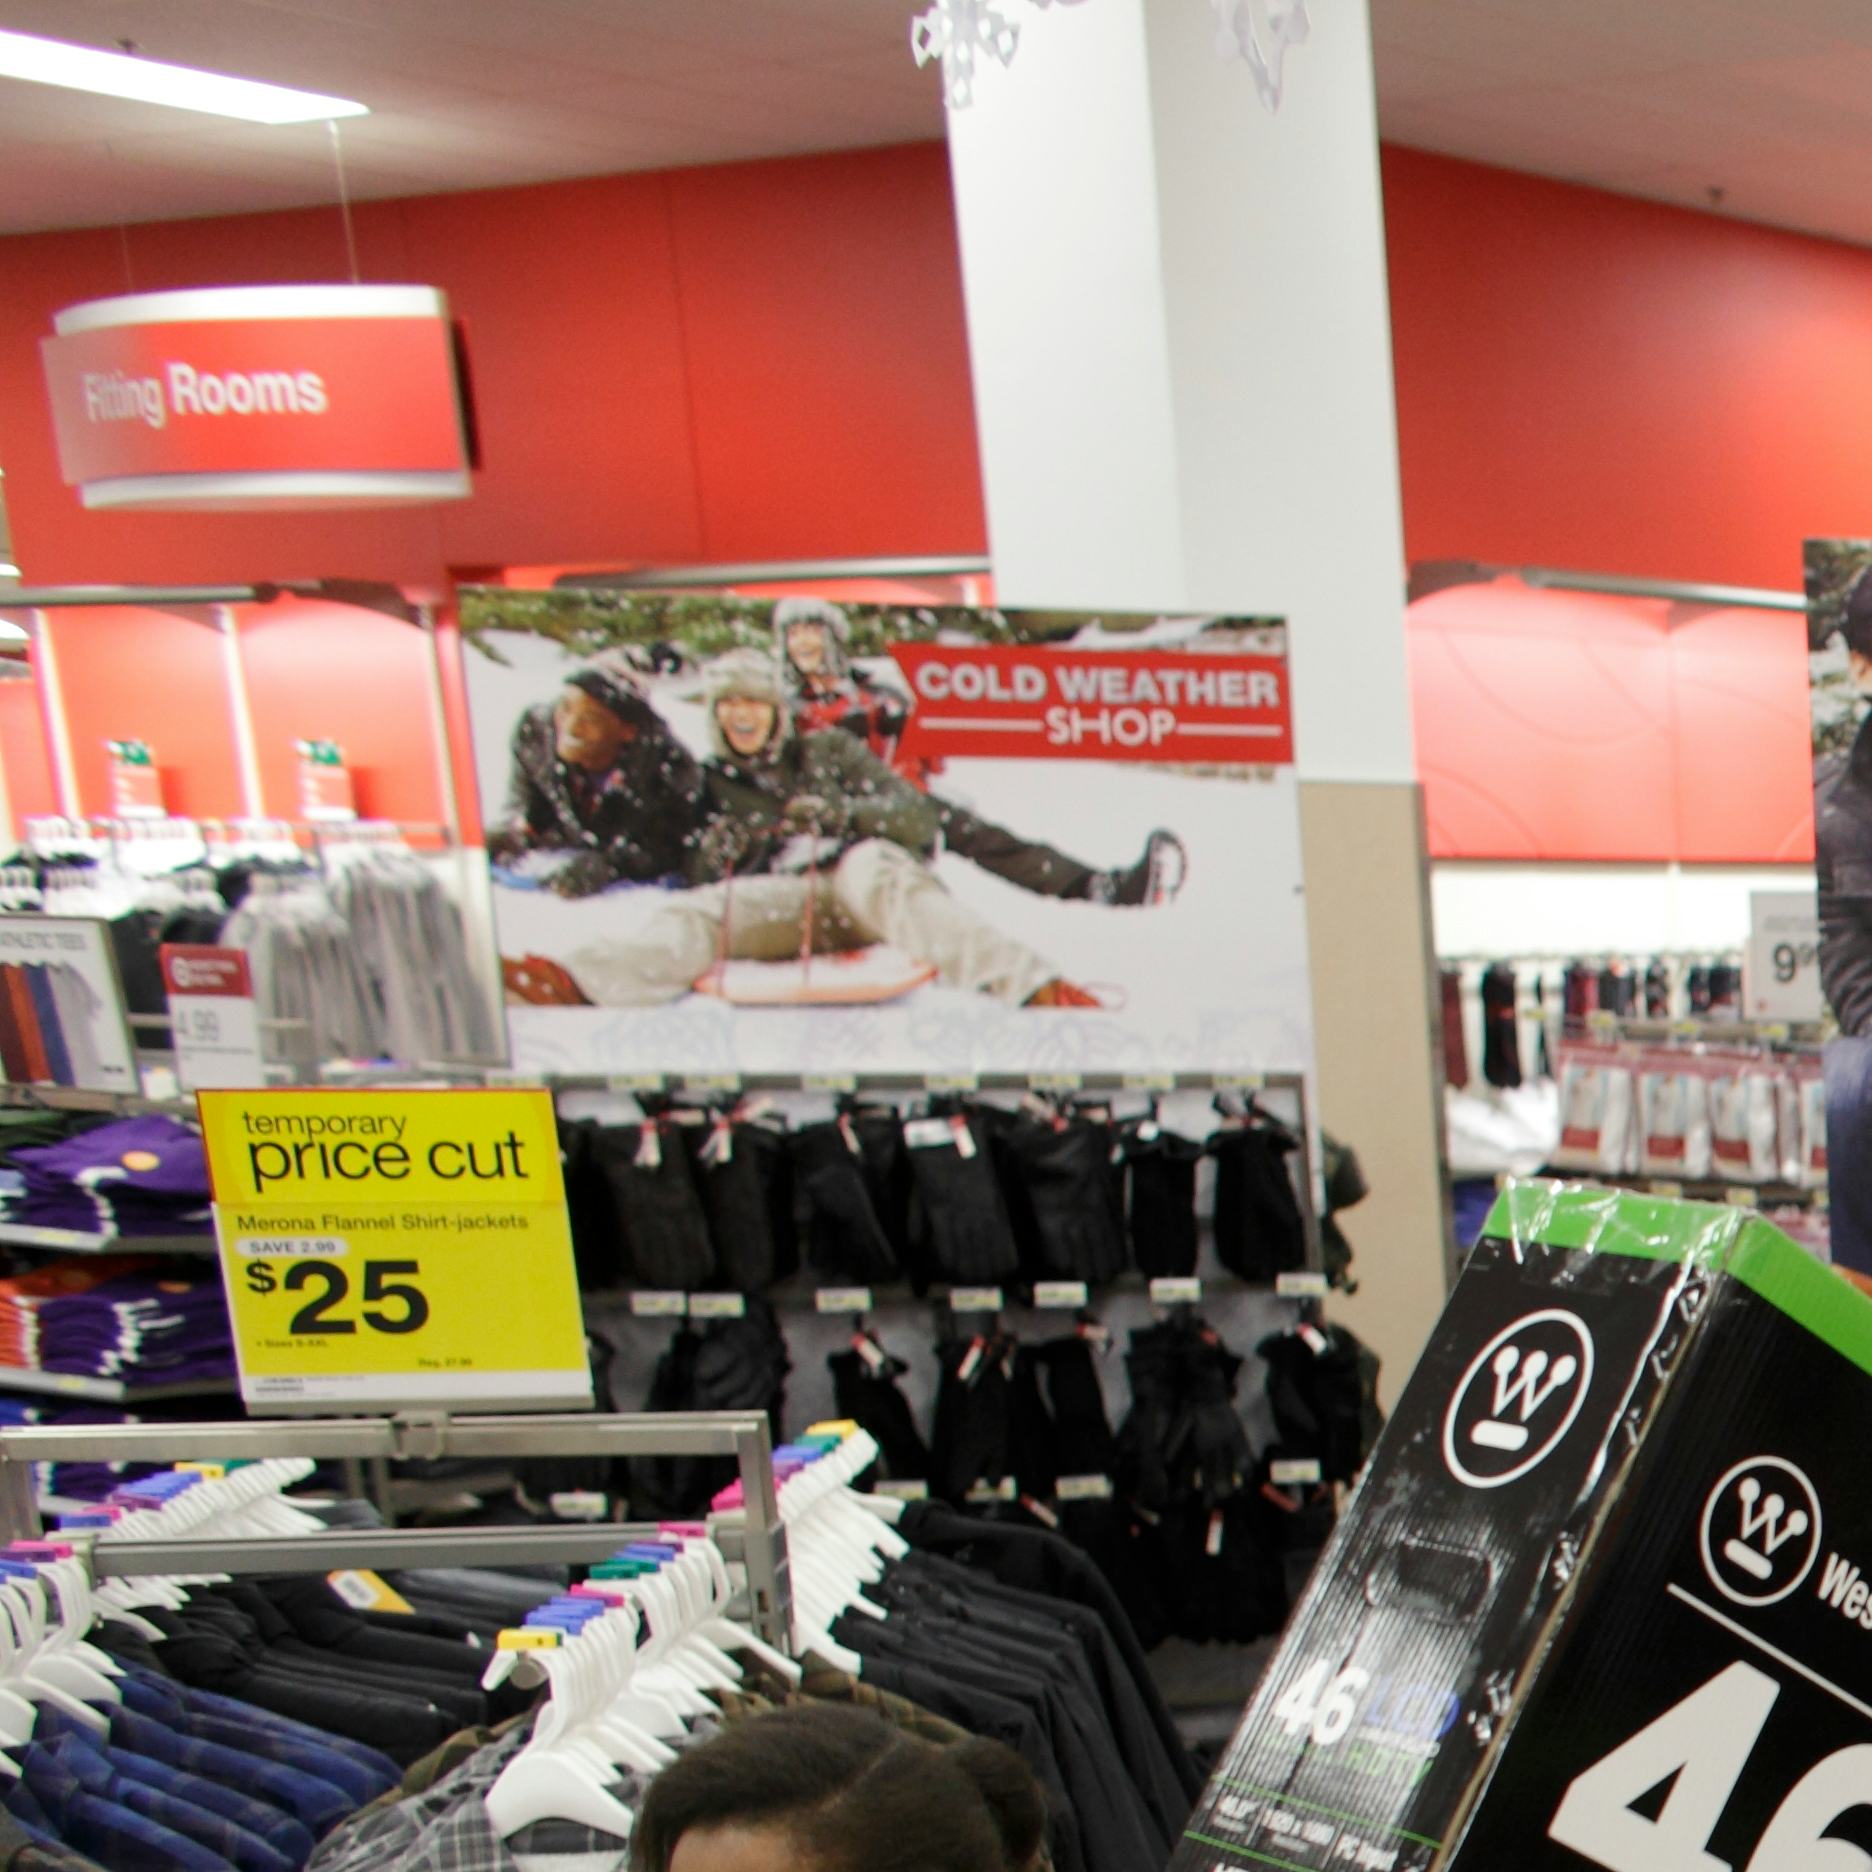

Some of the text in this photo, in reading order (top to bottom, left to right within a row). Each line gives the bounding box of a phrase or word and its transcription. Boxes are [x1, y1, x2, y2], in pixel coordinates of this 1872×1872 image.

[167, 360, 329, 416] Rooms
[915, 660, 1281, 708] COLD WEATHER
[1044, 706, 1176, 746] SHOP
[242, 1109, 407, 1144] temporary
[247, 1129, 530, 1194] price cut
[236, 1212, 529, 1234] Merona Flannel Shirt-jackets
[249, 1239, 337, 1255] SAVE 2.99
[245, 1258, 430, 1336] $25
[1274, 1658, 1371, 1746] 46
